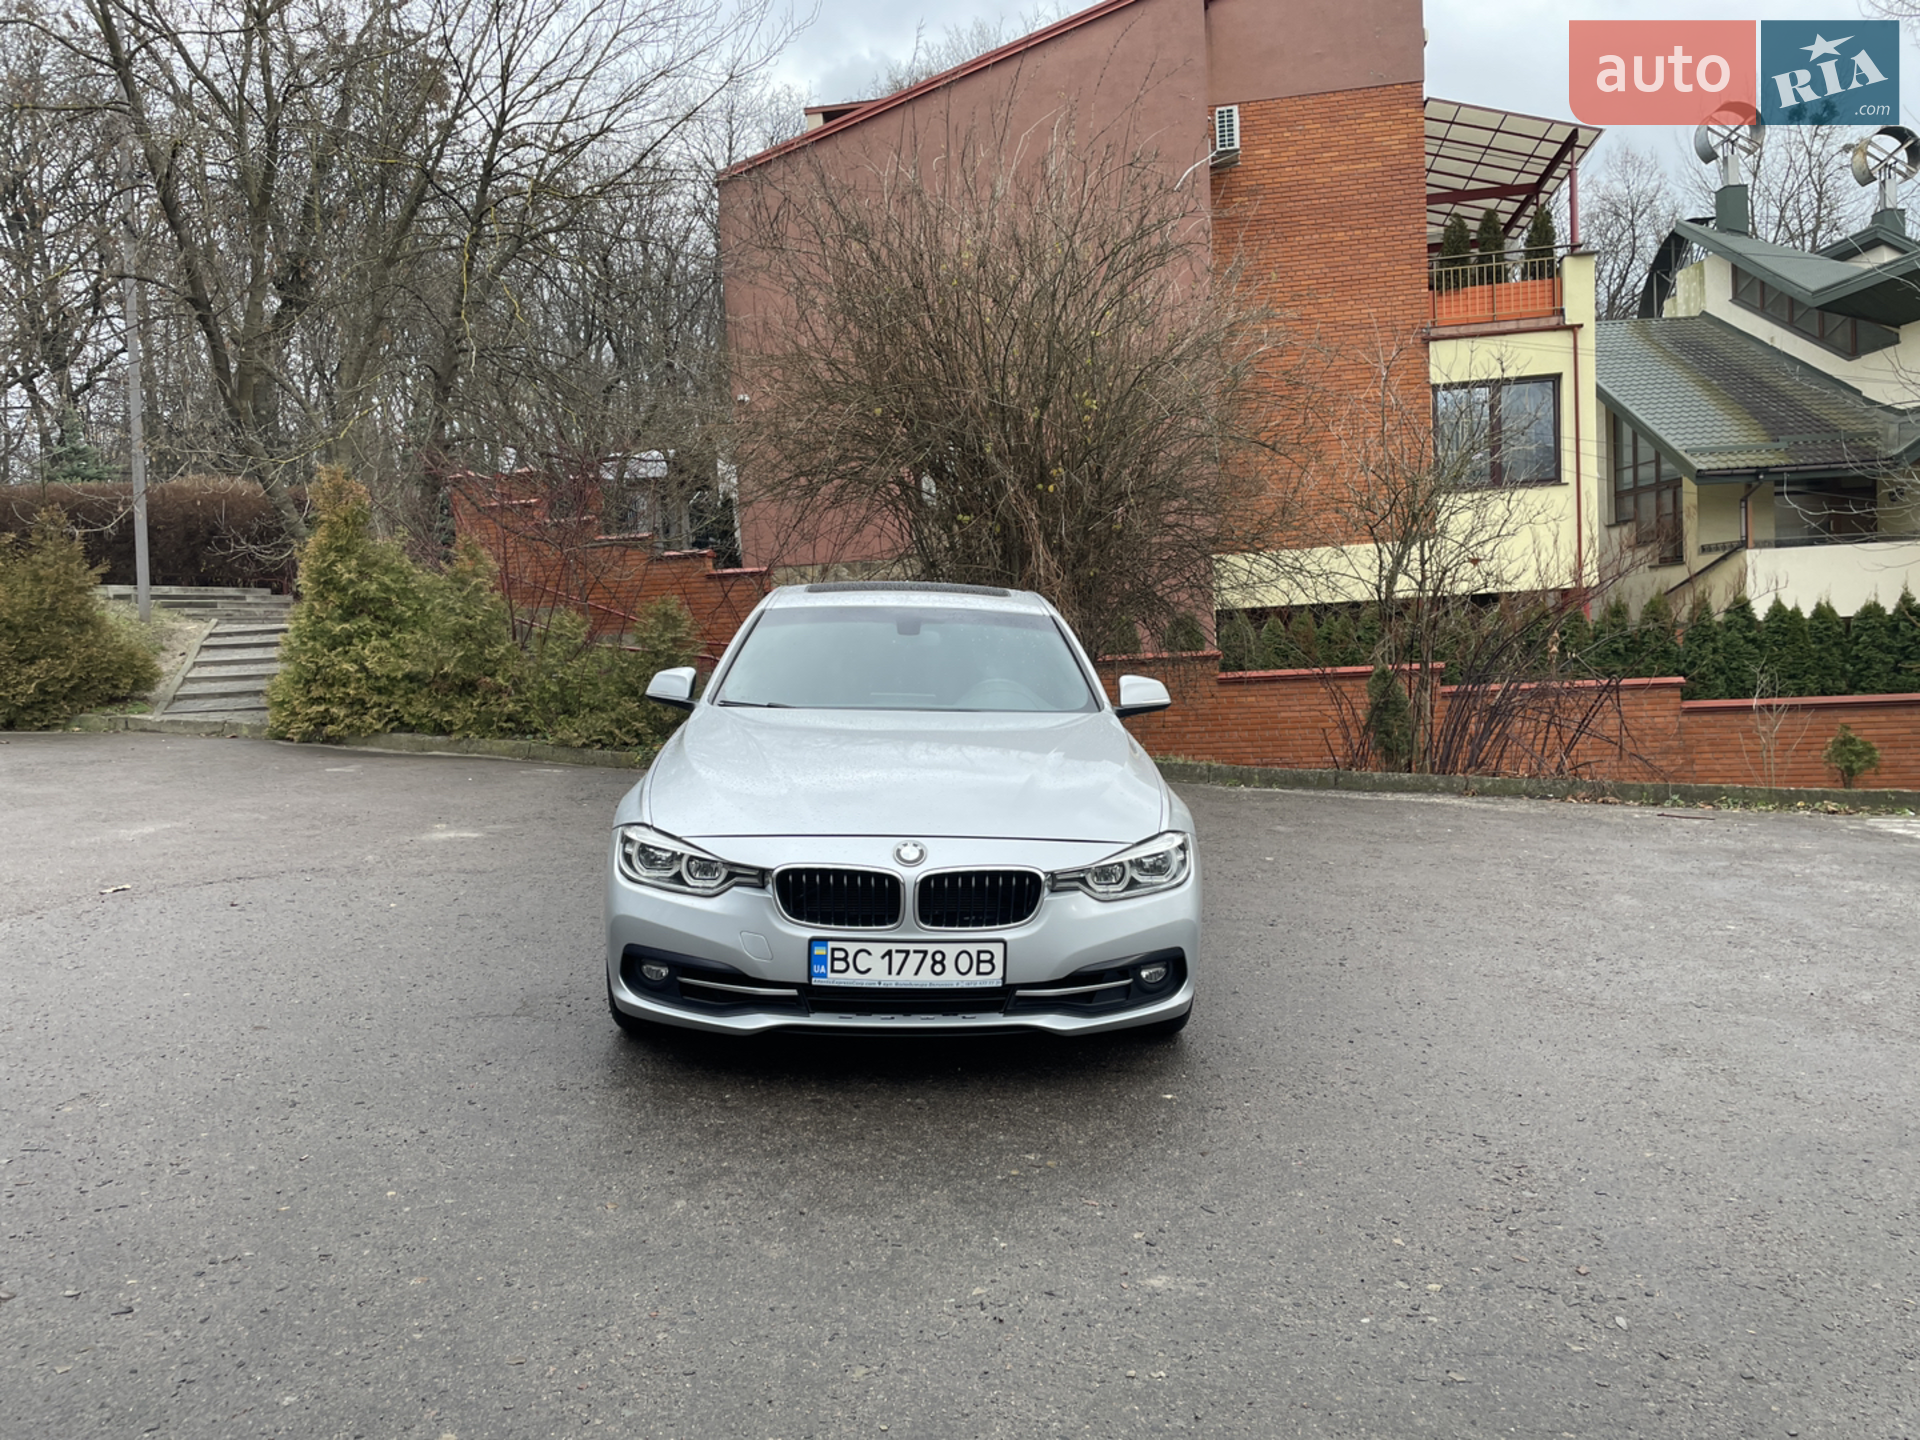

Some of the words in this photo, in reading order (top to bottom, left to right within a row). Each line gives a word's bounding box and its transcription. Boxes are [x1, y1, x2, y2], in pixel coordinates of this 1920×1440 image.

[813, 965, 826, 974] UA
[830, 947, 873, 975] BC
[880, 948, 947, 977] 1778
[954, 949, 996, 976] OB
